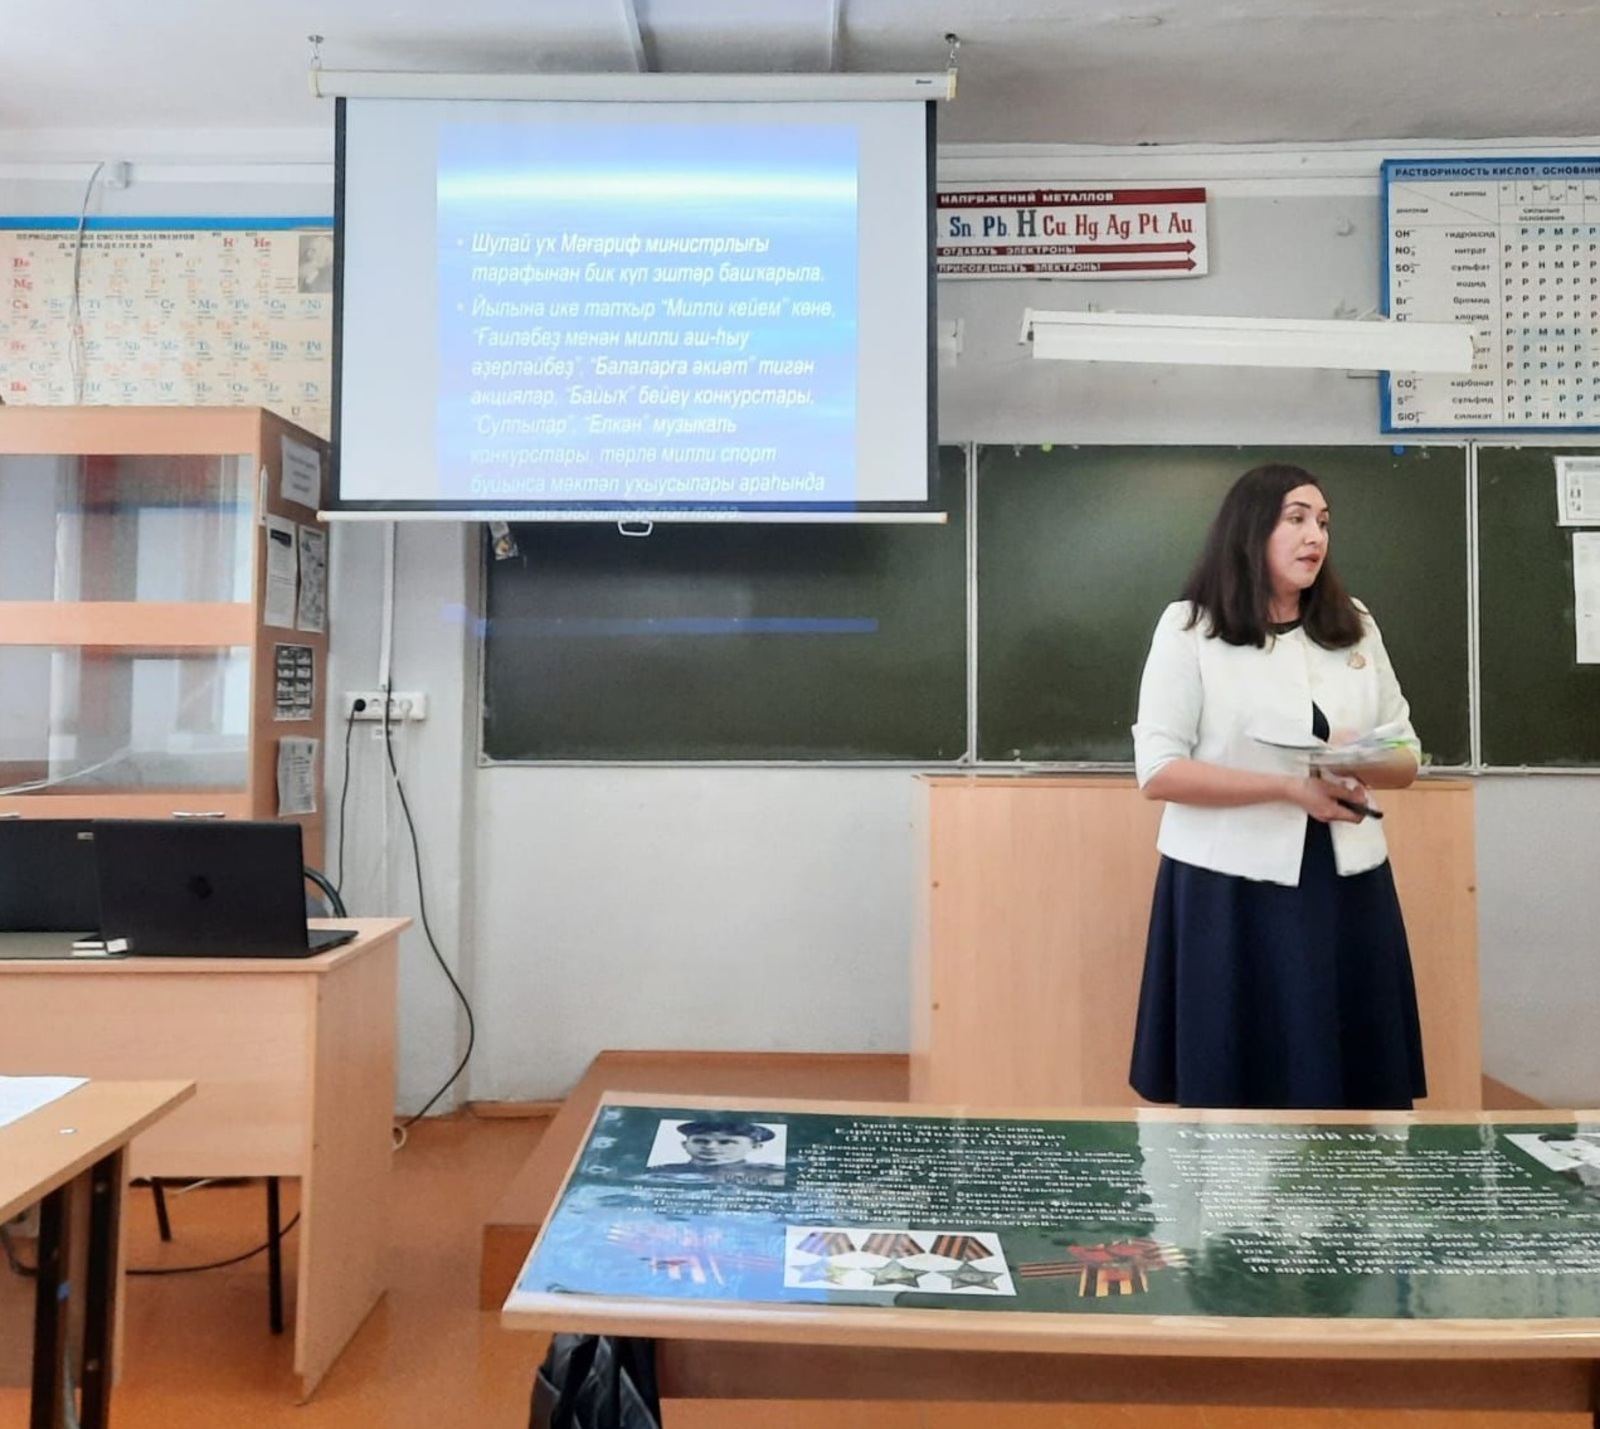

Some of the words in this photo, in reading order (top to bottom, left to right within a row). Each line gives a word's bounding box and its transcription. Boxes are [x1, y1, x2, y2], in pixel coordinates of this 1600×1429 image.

[1395, 167, 1489, 178] РАСТВОРИМОСТЬ
[940, 193, 1036, 205] НАПРЯЖЕНИЙ
[1043, 192, 1114, 203] МЕТАЛЛОВ
[949, 216, 972, 238] Sn
[983, 216, 1007, 238] Pb
[1017, 209, 1037, 237] H
[1043, 214, 1066, 236] Cu
[1075, 213, 1099, 241] Hg
[1107, 213, 1131, 240] Ag
[1138, 212, 1158, 234] Pt
[1167, 212, 1193, 234] Au
[1445, 231, 1496, 239] гидроксид
[472, 231, 531, 257] Шулай
[943, 247, 998, 256] ОТДАВАТЬ
[1006, 245, 1076, 255] ЭЛЕКТРОНЫ
[1455, 247, 1487, 256] нитрат
[472, 264, 579, 286] тарафынан
[585, 262, 615, 282] бик
[653, 266, 714, 286] эштәр
[939, 264, 1027, 273] ПРИСОЕДИНЯТЬ
[1033, 263, 1100, 272] ЭЛЕКТРОНЫ
[472, 293, 545, 317] Йылына
[565, 330, 619, 347] менән
[624, 330, 679, 347] милли
[759, 359, 815, 375] тигән
[652, 418, 737, 438] музыкаль
[661, 447, 716, 463] милли
[720, 447, 777, 467] спорт
[551, 476, 619, 493] мәктәп
[739, 471, 825, 497] араһында
[1177, 1130, 1342, 1141] Героический
